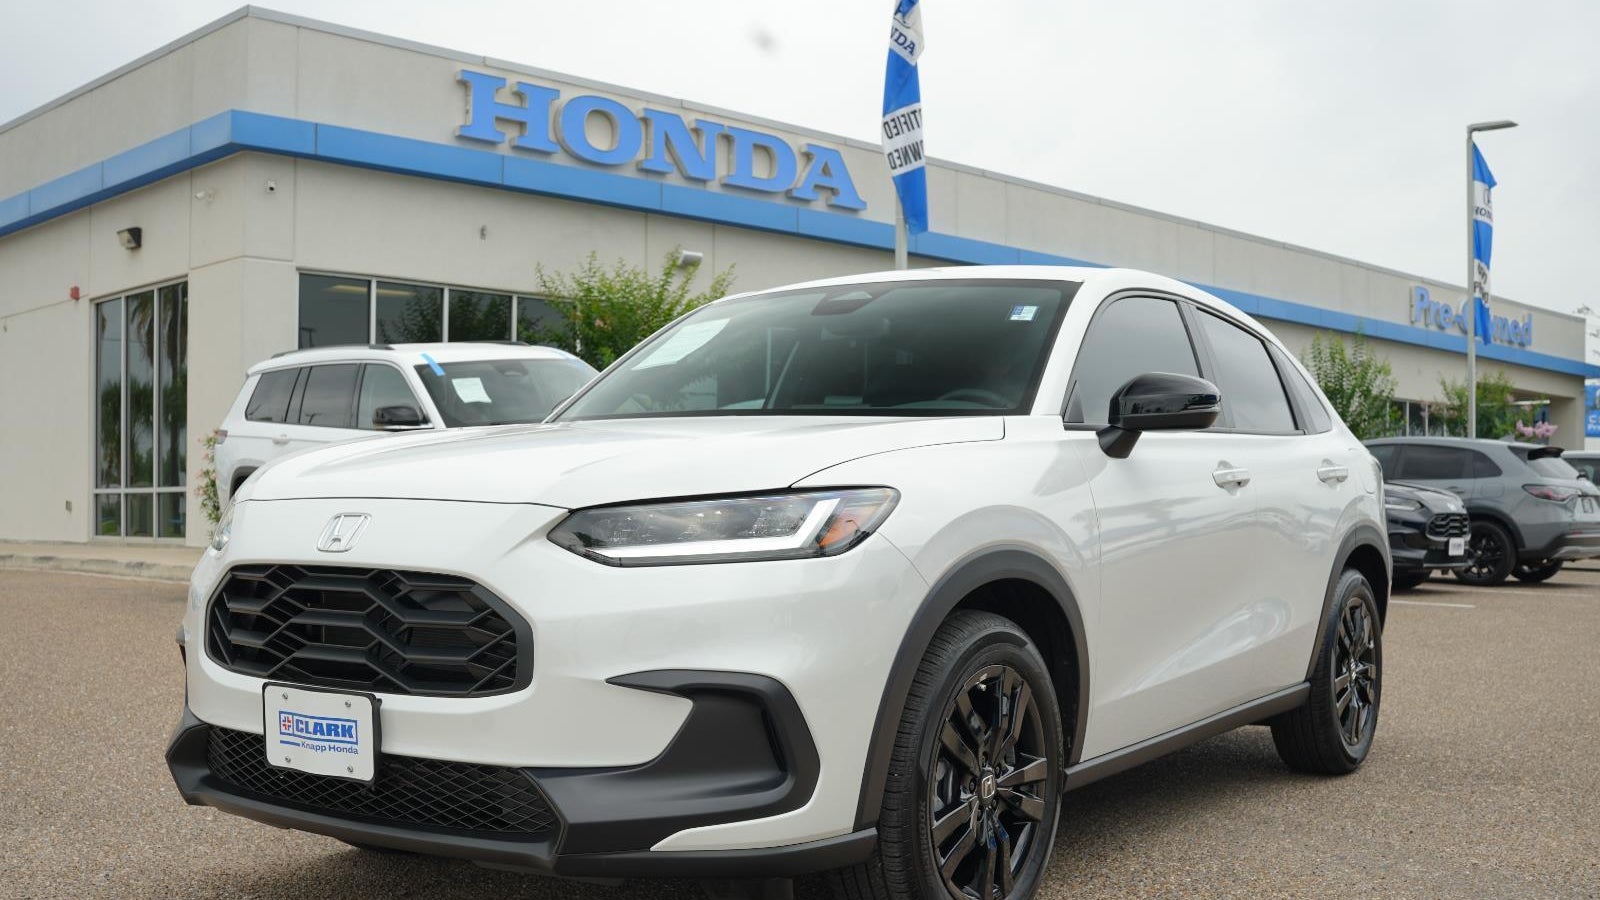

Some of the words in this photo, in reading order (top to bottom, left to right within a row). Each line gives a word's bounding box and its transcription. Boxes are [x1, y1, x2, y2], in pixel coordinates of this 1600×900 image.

[890, 26, 916, 56] NDA
[456, 69, 867, 212] HONDA
[1410, 285, 1532, 347] Pre-ned
[295, 719, 354, 738] CLARK
[301, 741, 327, 752] Knapp
[328, 744, 359, 755] Honda
